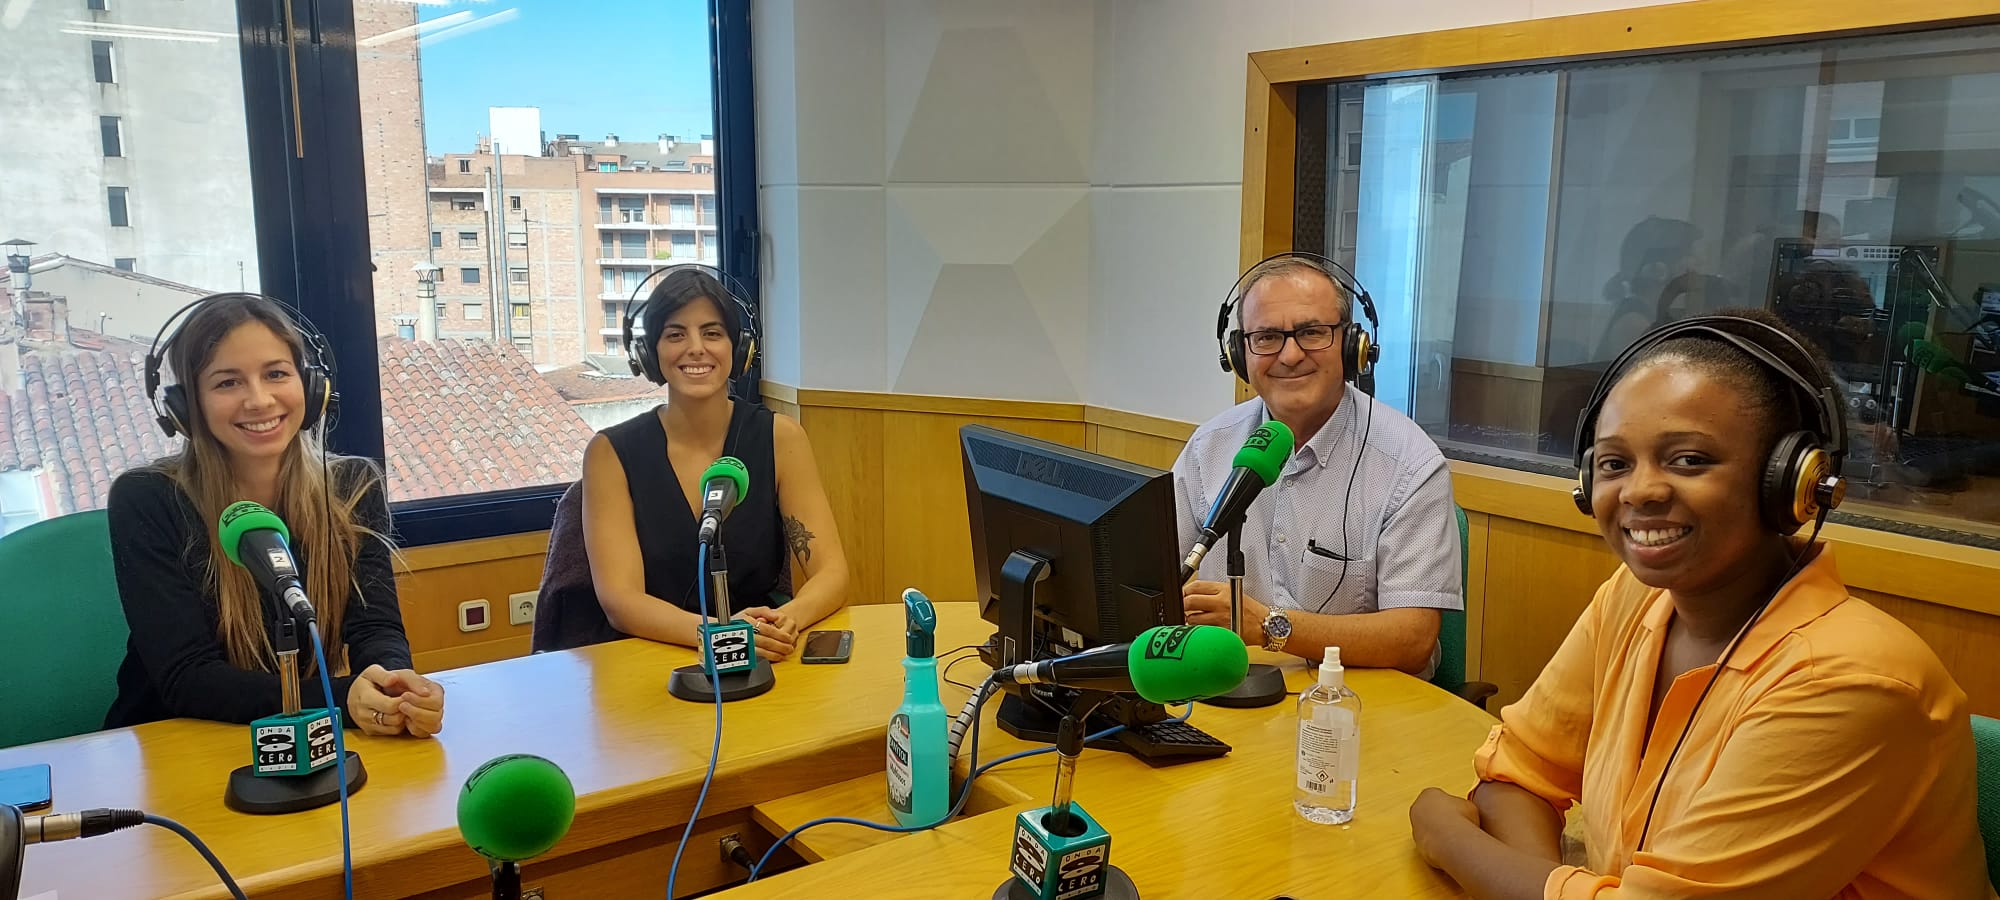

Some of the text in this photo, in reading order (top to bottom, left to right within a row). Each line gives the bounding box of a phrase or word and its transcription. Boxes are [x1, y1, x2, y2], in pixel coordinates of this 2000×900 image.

[714, 631, 744, 640] ONDA
[260, 727, 291, 735] ONDA
[310, 719, 329, 730] OND
[259, 753, 293, 763] CERO
[1021, 829, 1045, 855] ONDA
[1065, 847, 1101, 862] ONDA
[1015, 854, 1041, 884] CERO
[1058, 874, 1097, 892] CERO
